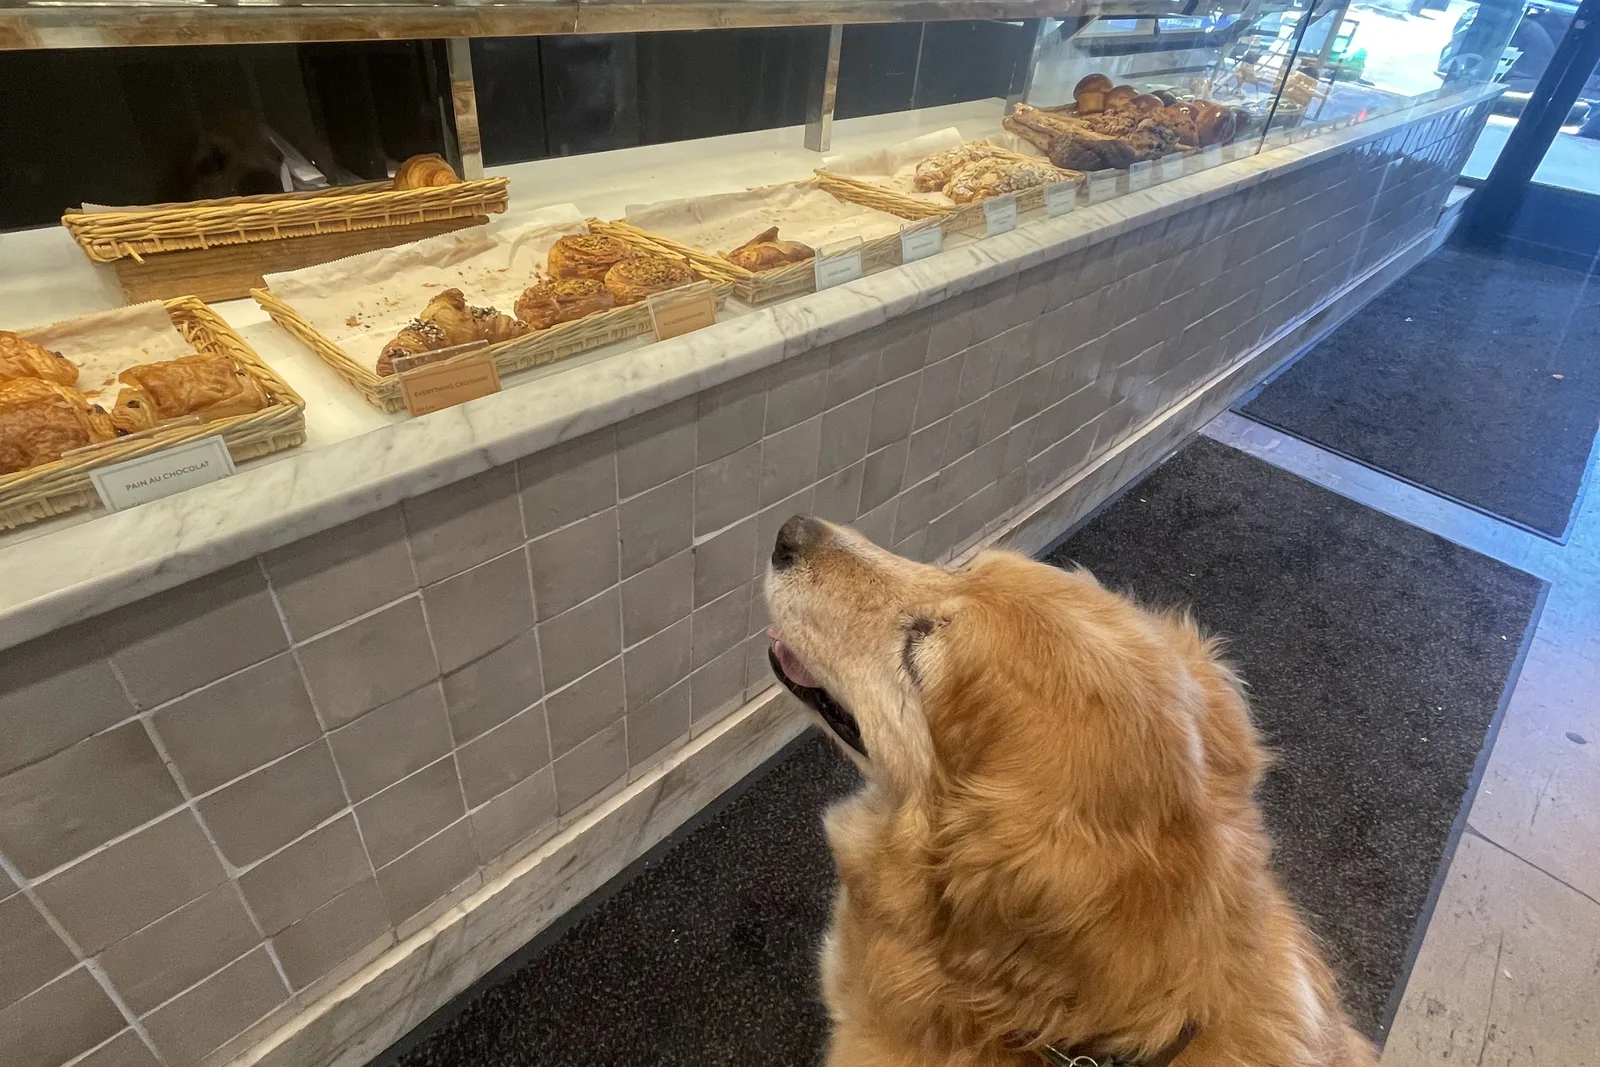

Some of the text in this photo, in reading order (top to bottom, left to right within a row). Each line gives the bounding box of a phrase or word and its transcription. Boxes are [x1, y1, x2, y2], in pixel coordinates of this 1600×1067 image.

[414, 375, 489, 398] EVERYTHING CROISSANT
[125, 480, 148, 491] PAIN
[149, 475, 162, 485] AU
[163, 460, 210, 480] CHOCOLAT
